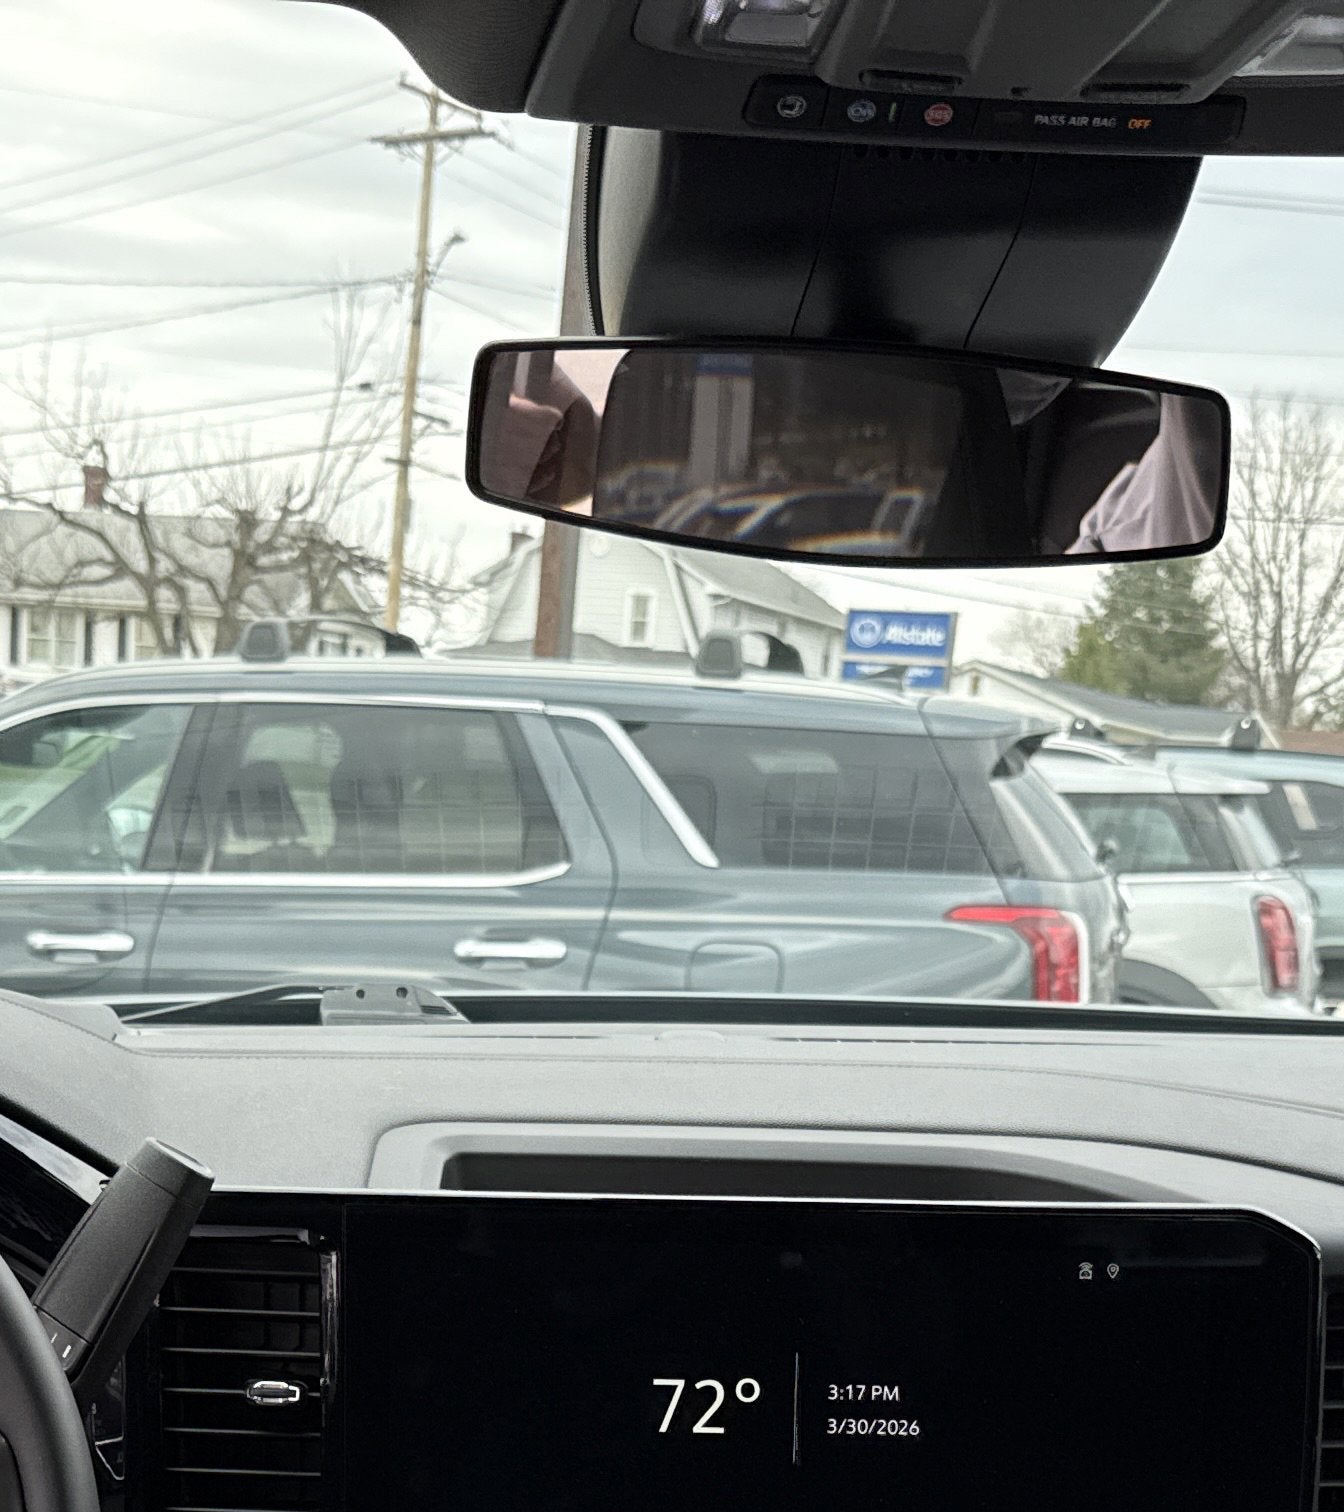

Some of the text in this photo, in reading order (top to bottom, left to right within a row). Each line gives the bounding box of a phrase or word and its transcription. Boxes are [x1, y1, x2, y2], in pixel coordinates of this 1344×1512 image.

[1034, 115, 1152, 129] PASS AIR BAG OFF
[827, 1384, 900, 1401] 3:17 PM
[652, 1377, 762, 1435] 72°
[826, 1418, 920, 1436] 3/30/2026
